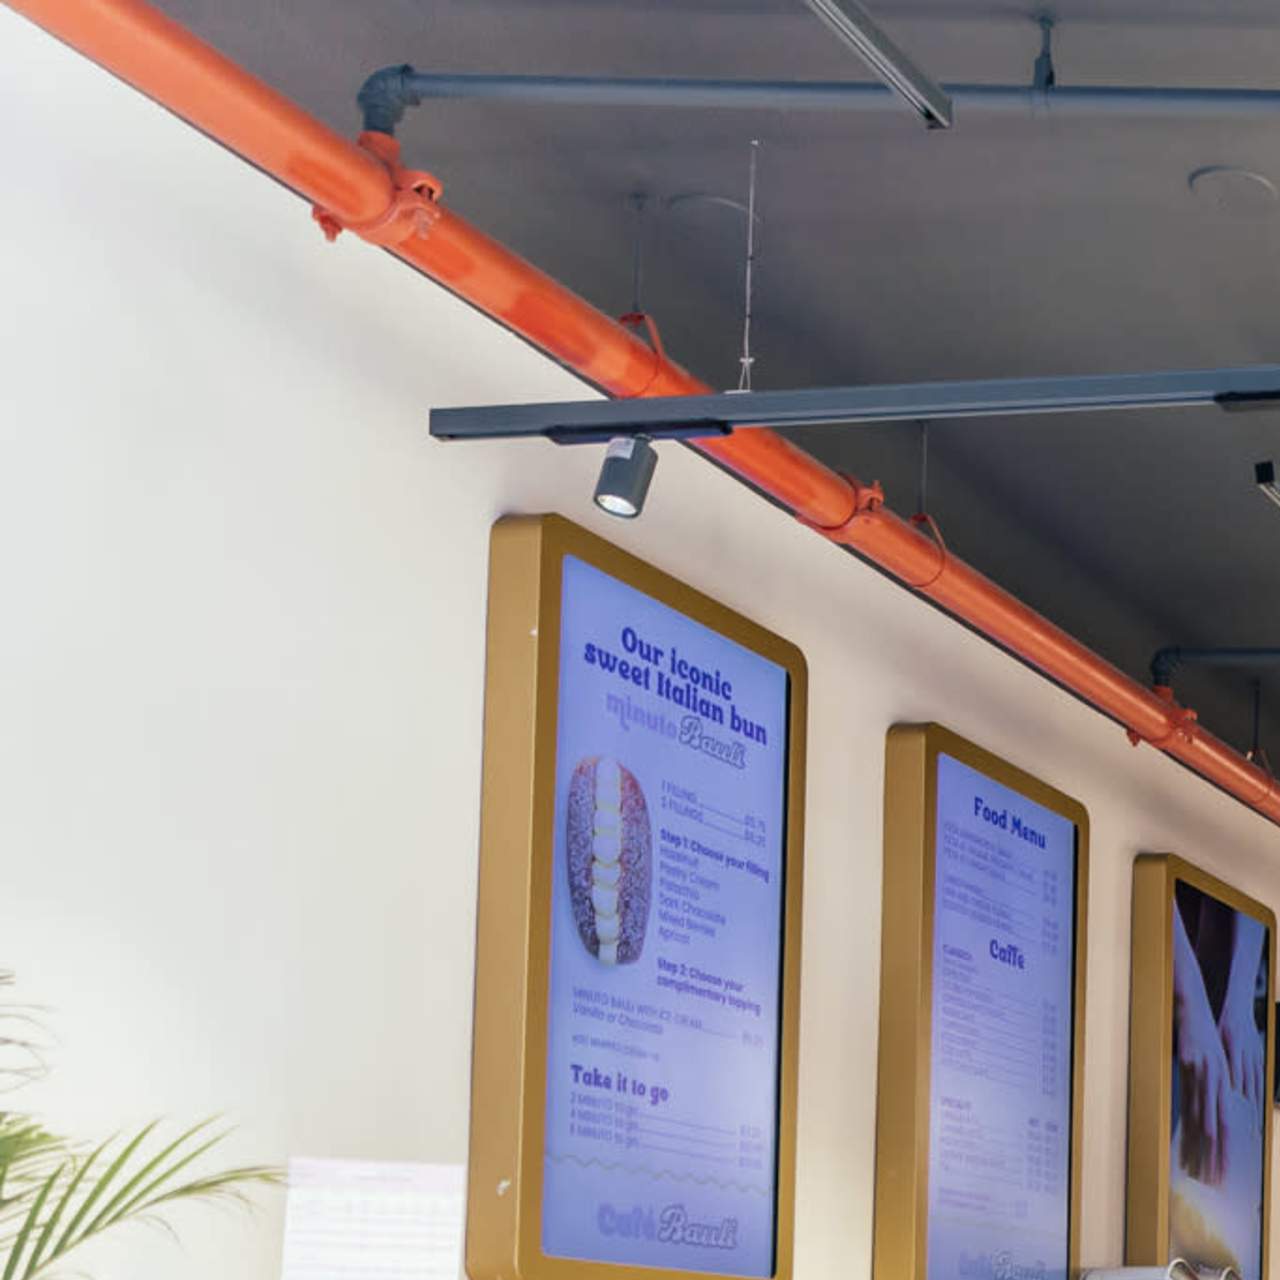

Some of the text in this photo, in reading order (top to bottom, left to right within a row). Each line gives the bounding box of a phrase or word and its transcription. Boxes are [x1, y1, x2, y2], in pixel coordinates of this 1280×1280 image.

[621, 626, 732, 701] Our iconic
[583, 643, 767, 746] sweet Italian bun
[974, 796, 1008, 830] Food
[1010, 815, 1046, 850] Menu
[660, 828, 682, 848] Step
[690, 840, 724, 861] Choose
[726, 855, 745, 869] your
[657, 957, 678, 975] Step
[689, 966, 722, 986] Choose
[570, 1064, 669, 1106] Take it to go
[658, 1203, 738, 1250] Bauli
